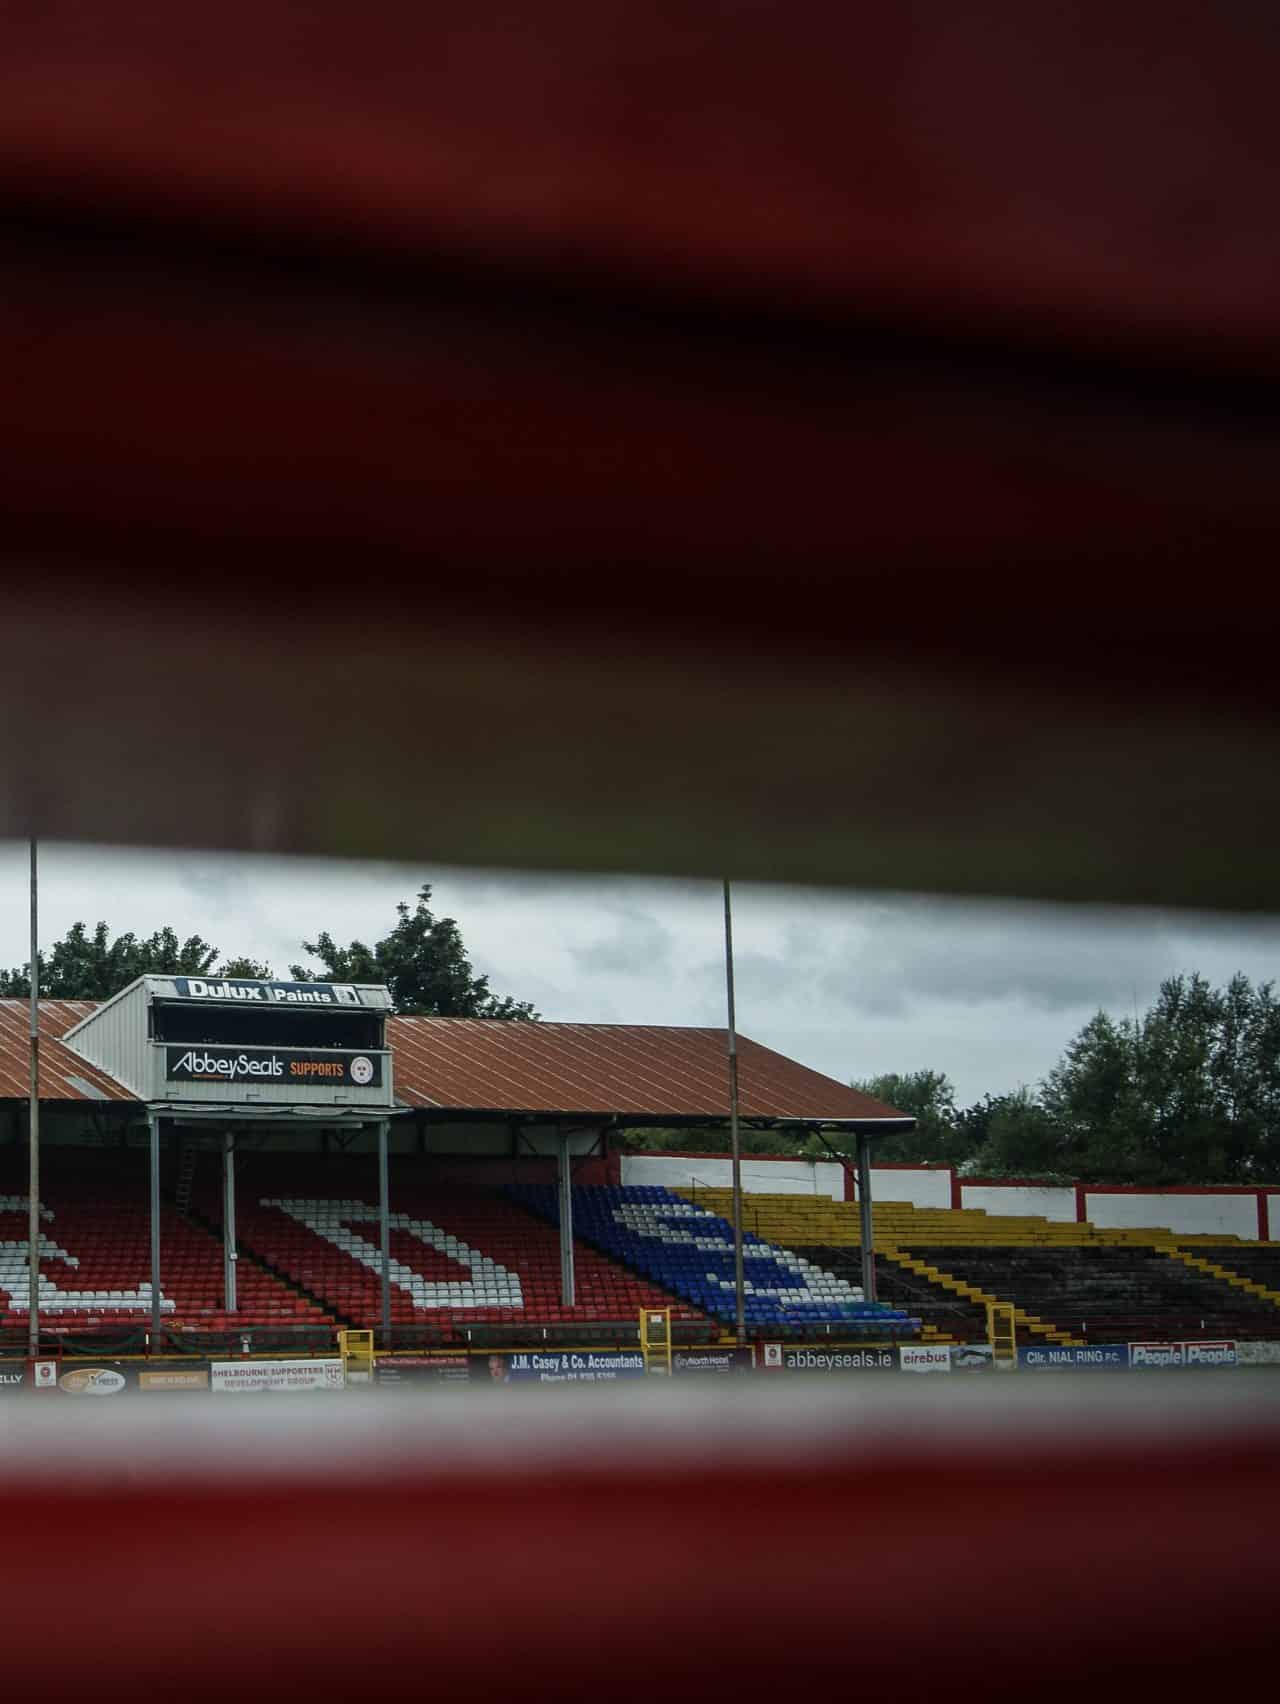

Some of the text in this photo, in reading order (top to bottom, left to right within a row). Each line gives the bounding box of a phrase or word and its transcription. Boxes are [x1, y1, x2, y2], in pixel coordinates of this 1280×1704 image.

[187, 980, 332, 1003] Dulux Paints
[172, 1051, 344, 1079] AbbeySeals SUPPORTS
[511, 1353, 643, 1373] J.M. Casey & Co. Accountants
[787, 1351, 892, 1370] abbeyseals.ie
[903, 1352, 947, 1365] eirebus
[1049, 1351, 1074, 1363] NIAL
[1077, 1350, 1104, 1363] RING
[1132, 1346, 1182, 1367] People
[1187, 1344, 1235, 1365] People
[213, 1368, 267, 1378] SHELBOURNE
